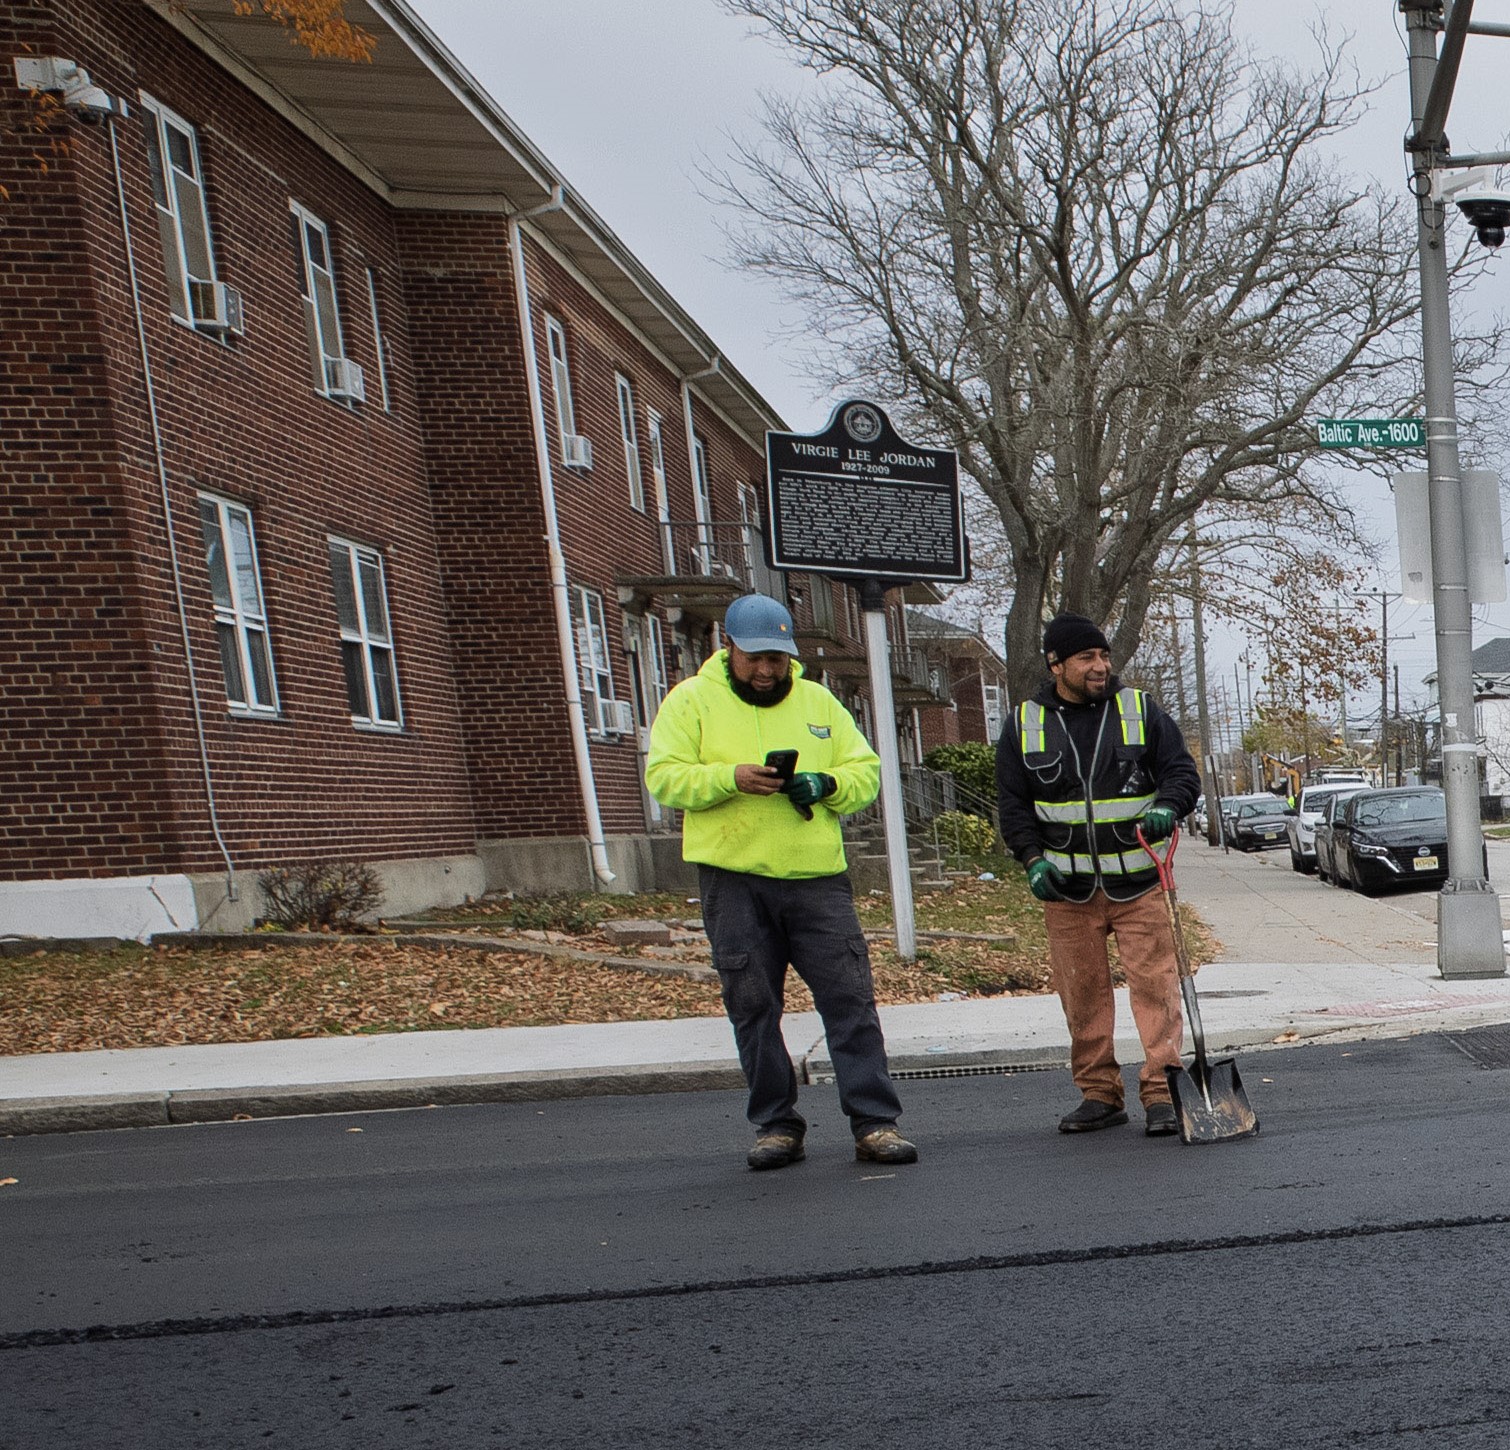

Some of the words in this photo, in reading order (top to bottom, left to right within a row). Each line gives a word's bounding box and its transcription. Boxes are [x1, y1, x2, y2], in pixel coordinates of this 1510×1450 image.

[1317, 423, 1352, 443] Baltic
[791, 442, 839, 459] VIRGIE
[848, 448, 871, 462] LEE
[880, 452, 936, 468] JORDAN
[841, 461, 890, 475] 1927-2009
